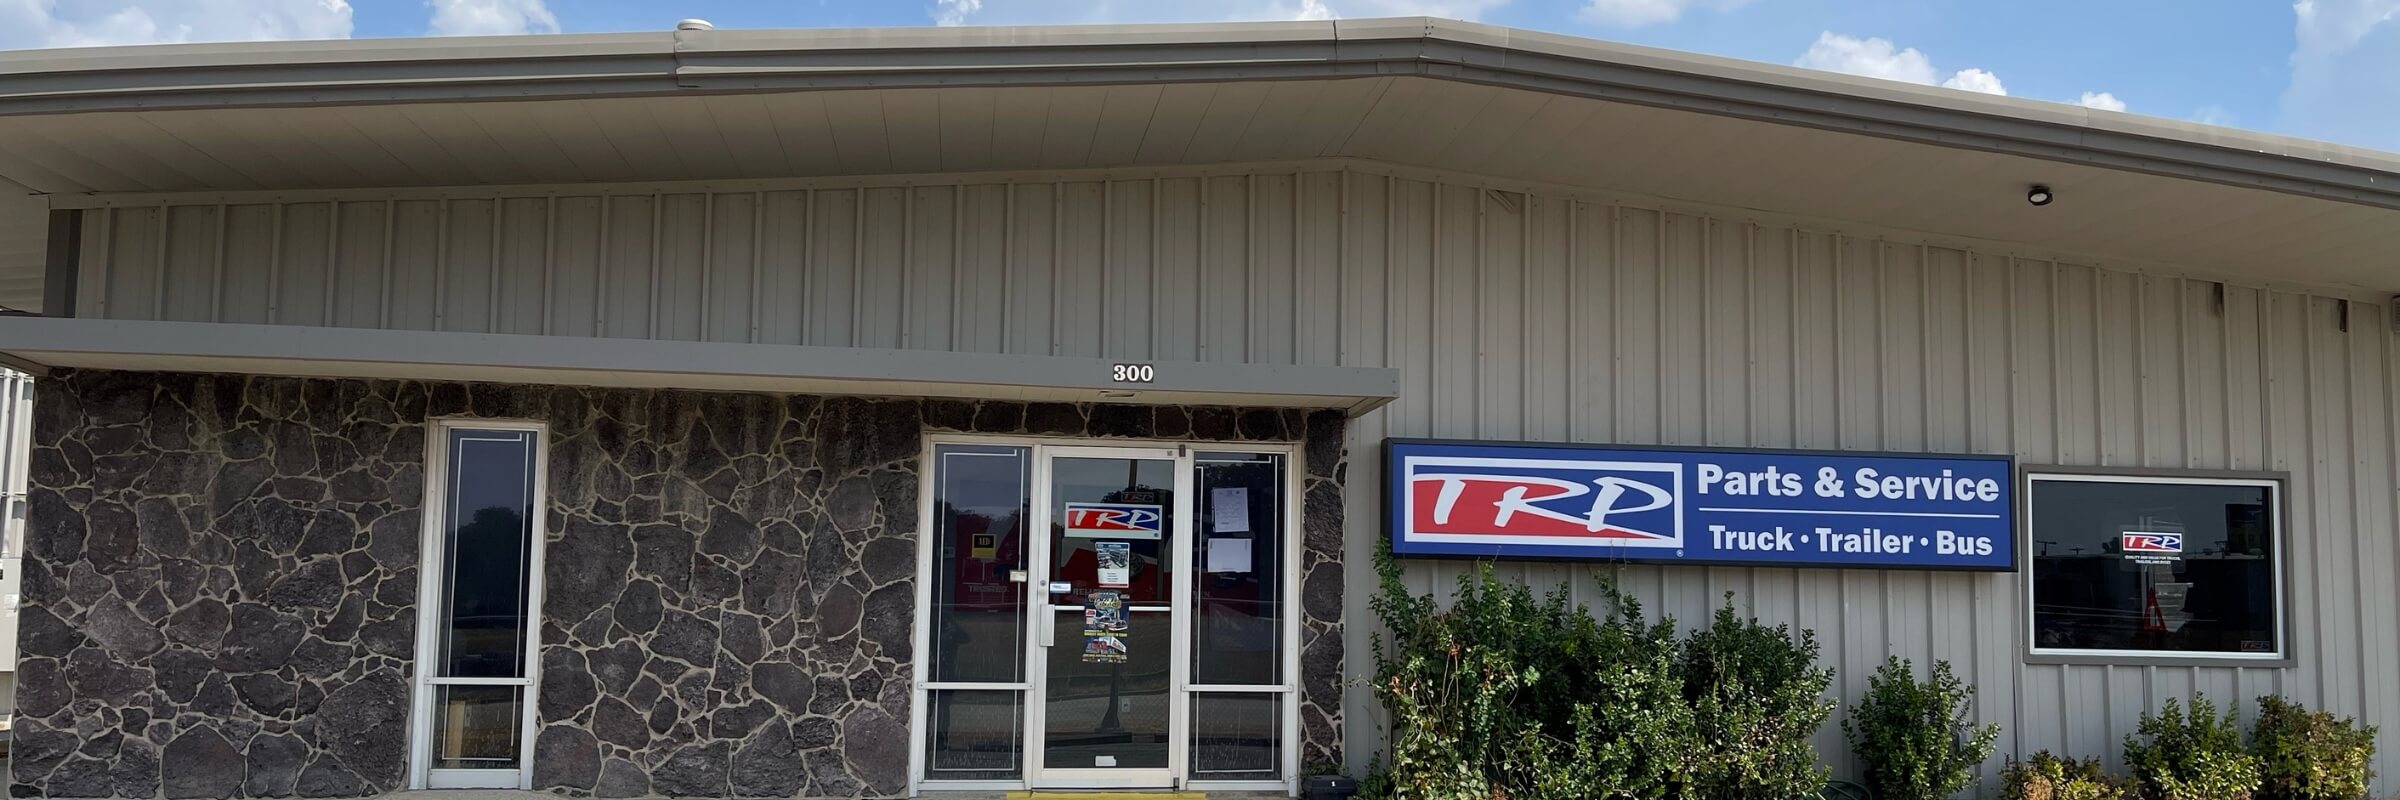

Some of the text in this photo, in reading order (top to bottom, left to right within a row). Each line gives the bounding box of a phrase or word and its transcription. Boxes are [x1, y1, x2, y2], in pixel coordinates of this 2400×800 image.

[1113, 364, 1154, 382] 300
[1697, 463, 2000, 502] Parts & Service
[1067, 508, 1160, 531] TRP
[1411, 472, 1674, 541] TRP
[1708, 524, 1993, 556] Truck Trailer Bus
[2124, 535, 2180, 551] TRP
